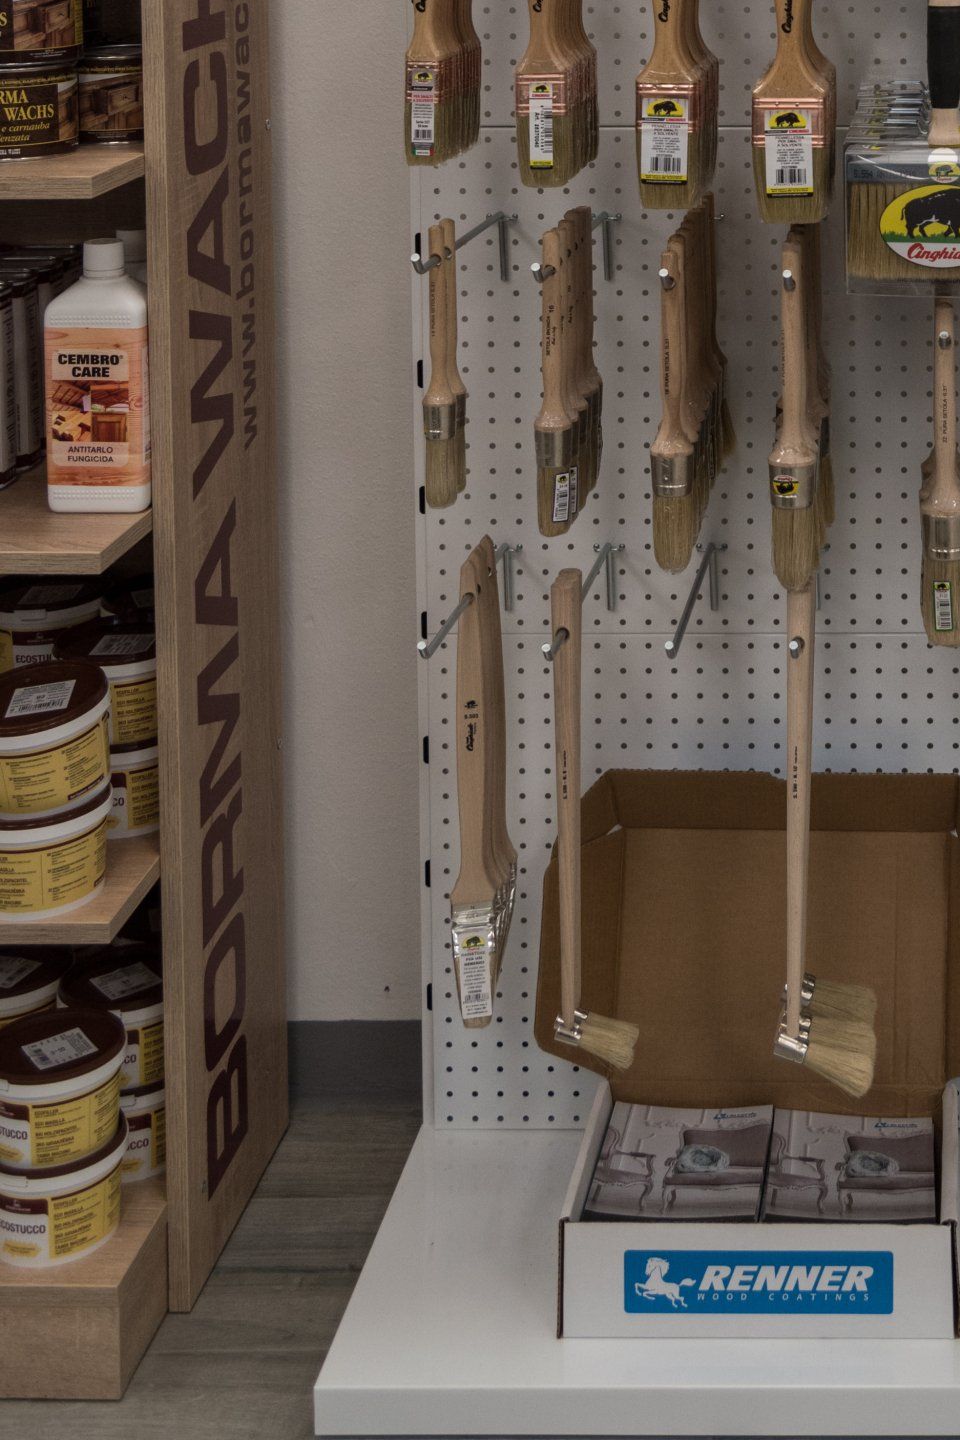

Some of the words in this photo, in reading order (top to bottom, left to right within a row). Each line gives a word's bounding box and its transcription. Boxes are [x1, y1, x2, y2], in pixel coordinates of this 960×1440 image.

[5, 104, 55, 121] WACHS
[8, 122, 50, 132] carnauba
[71, 366, 110, 378] CARE
[68, 446, 113, 454] ANTITARLO
[67, 455, 114, 464] FUNGICIDA
[15, 654, 52, 663] ECOSTU
[698, 1264, 875, 1292] RENNER
[697, 1292, 748, 1301] WOOD
[768, 1292, 871, 1301] COATINGS
